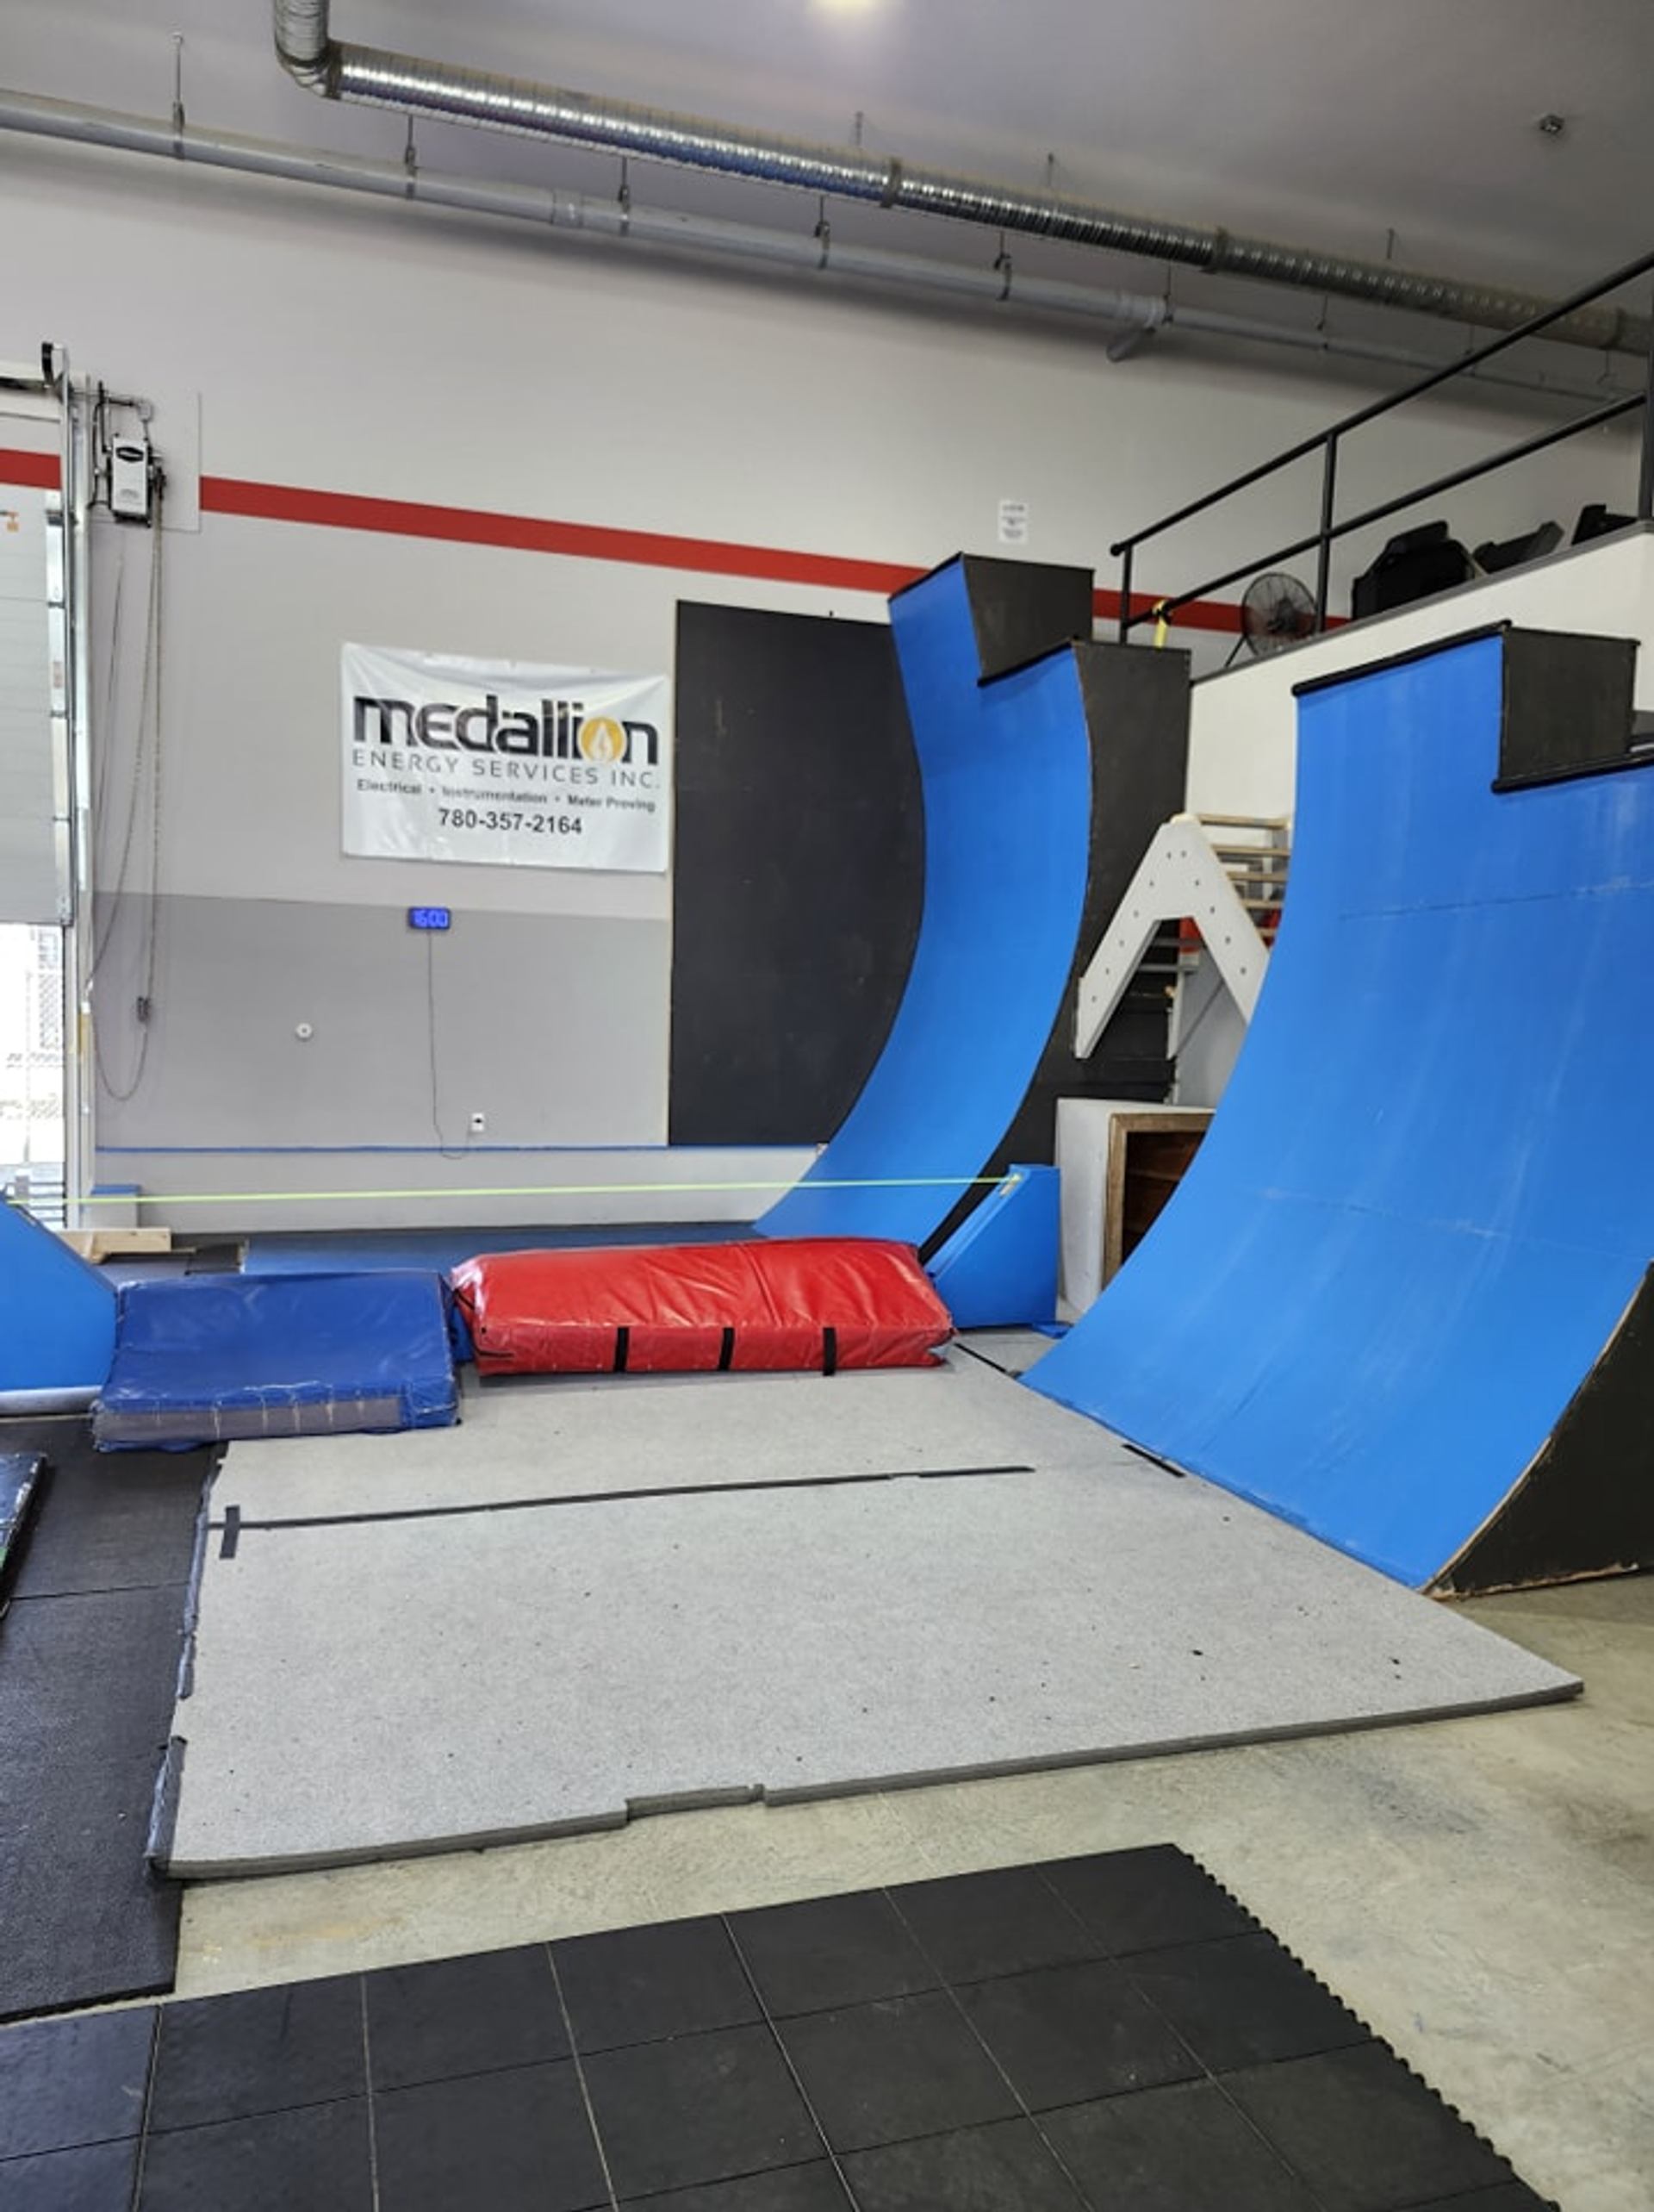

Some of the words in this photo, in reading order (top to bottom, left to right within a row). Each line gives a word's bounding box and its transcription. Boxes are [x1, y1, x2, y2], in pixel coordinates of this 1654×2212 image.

[353, 695, 658, 766] medallion
[352, 749, 459, 774] ENERGY
[472, 758, 599, 785] SERVICES
[611, 770, 661, 789] INC.
[357, 778, 422, 794] Electrical
[442, 785, 548, 804] Instrumentation
[568, 794, 602, 807] Meter
[606, 796, 656, 813] Proving
[438, 807, 582, 834] 780-357-2164
